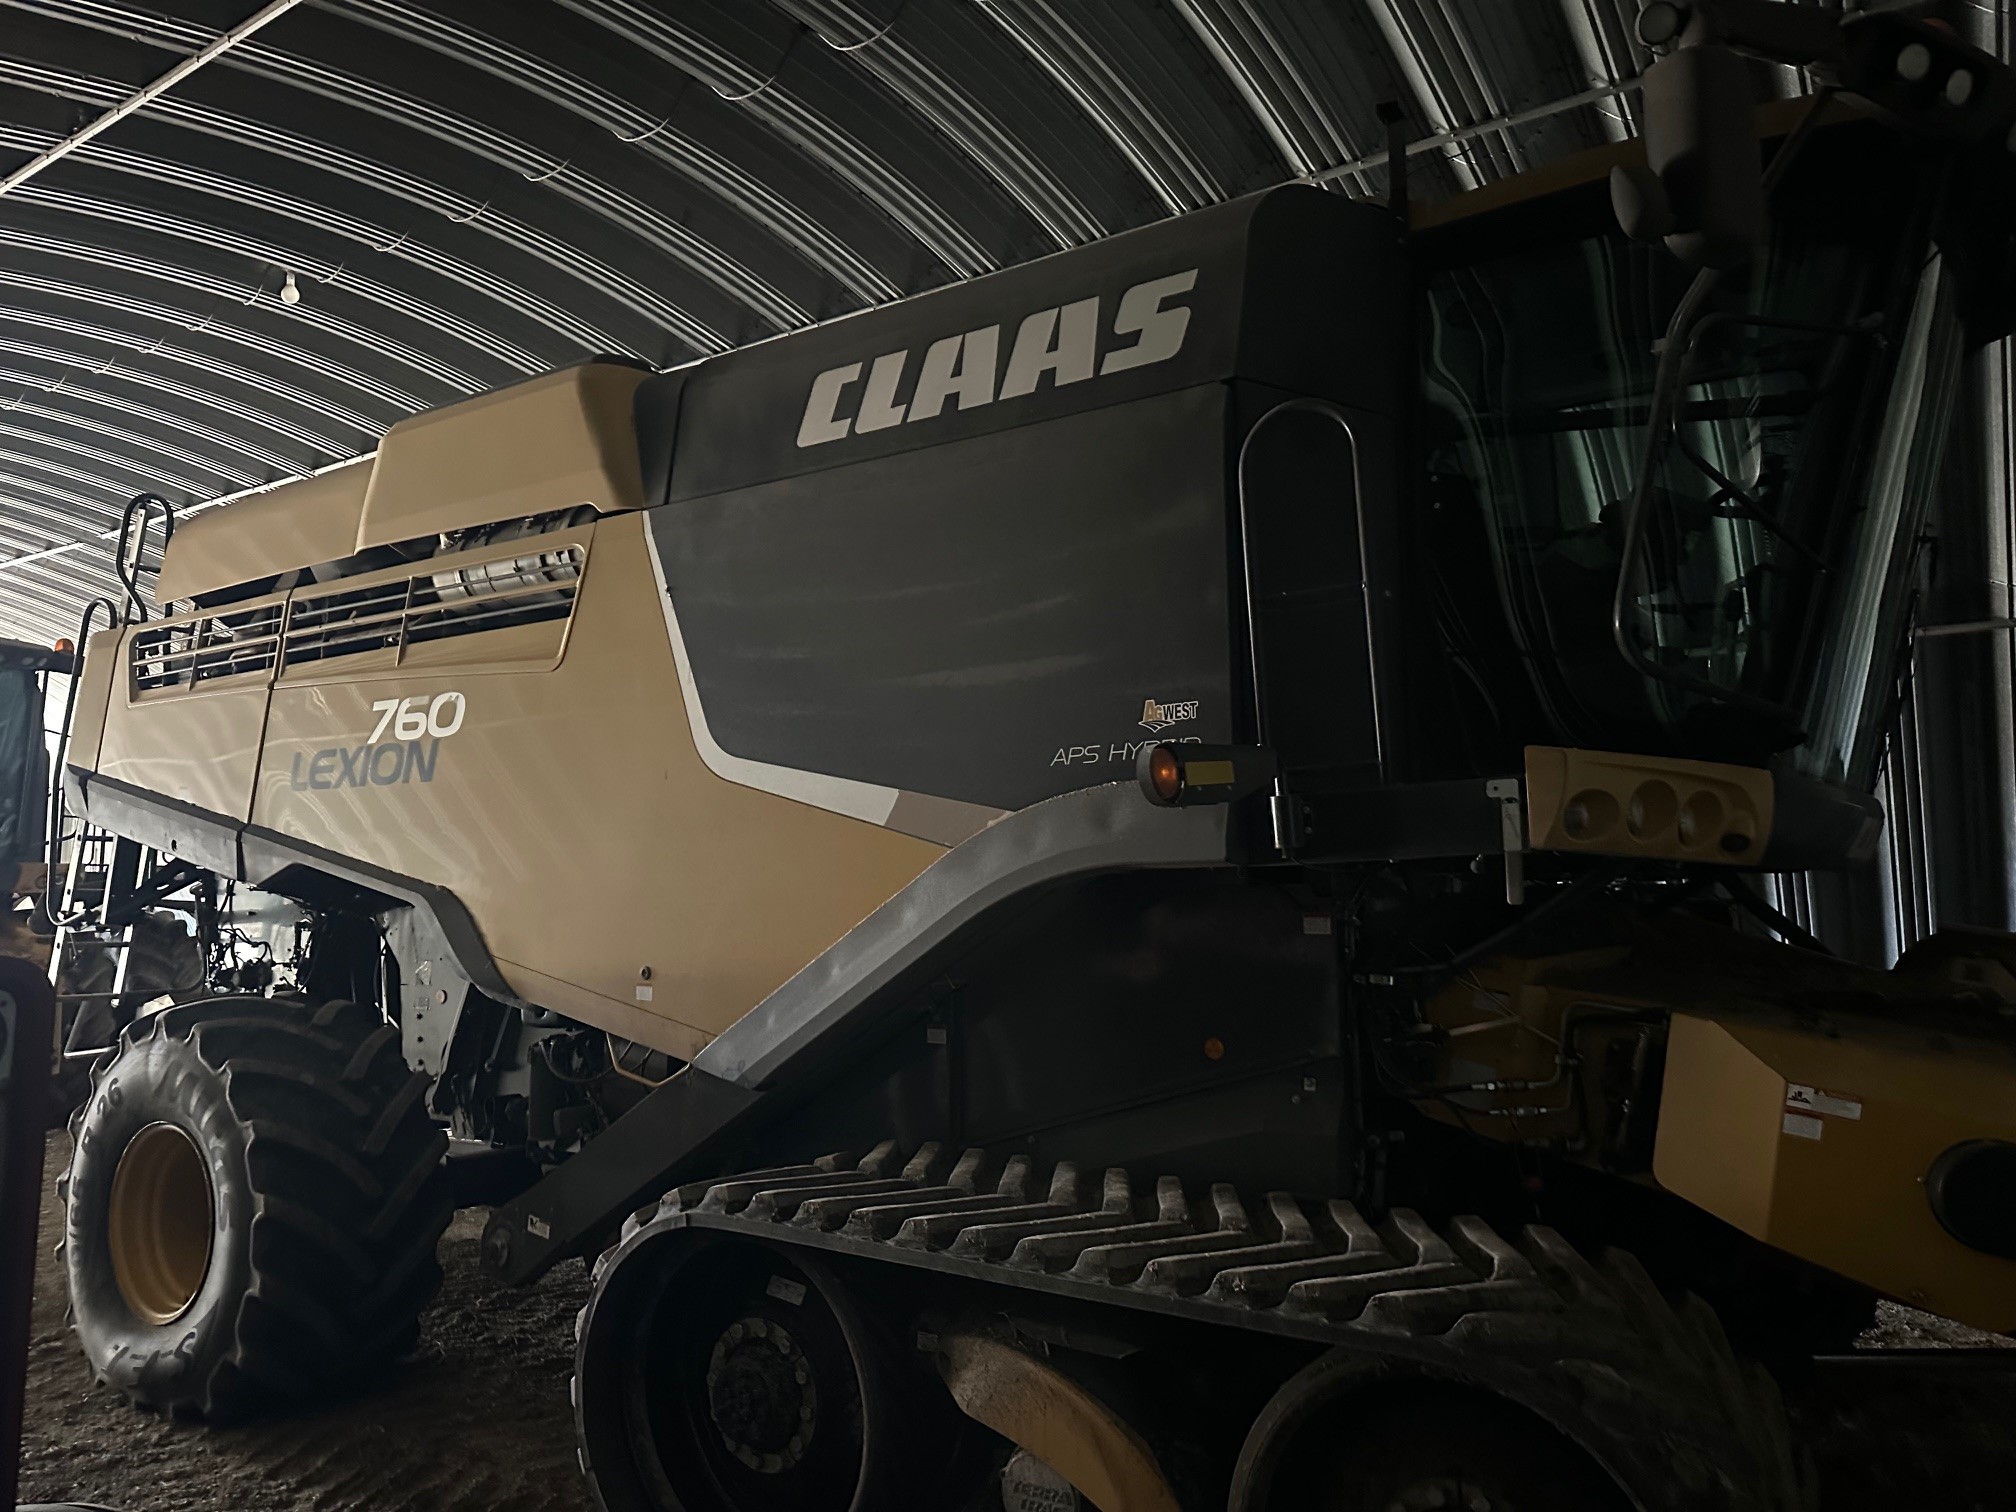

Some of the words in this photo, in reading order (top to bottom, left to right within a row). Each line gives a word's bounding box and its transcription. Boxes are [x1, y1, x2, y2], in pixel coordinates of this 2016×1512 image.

[797, 268, 1199, 448] CLAAS
[367, 691, 466, 745] 760
[290, 738, 440, 792] LEXION
[1050, 745, 1101, 767] APS
